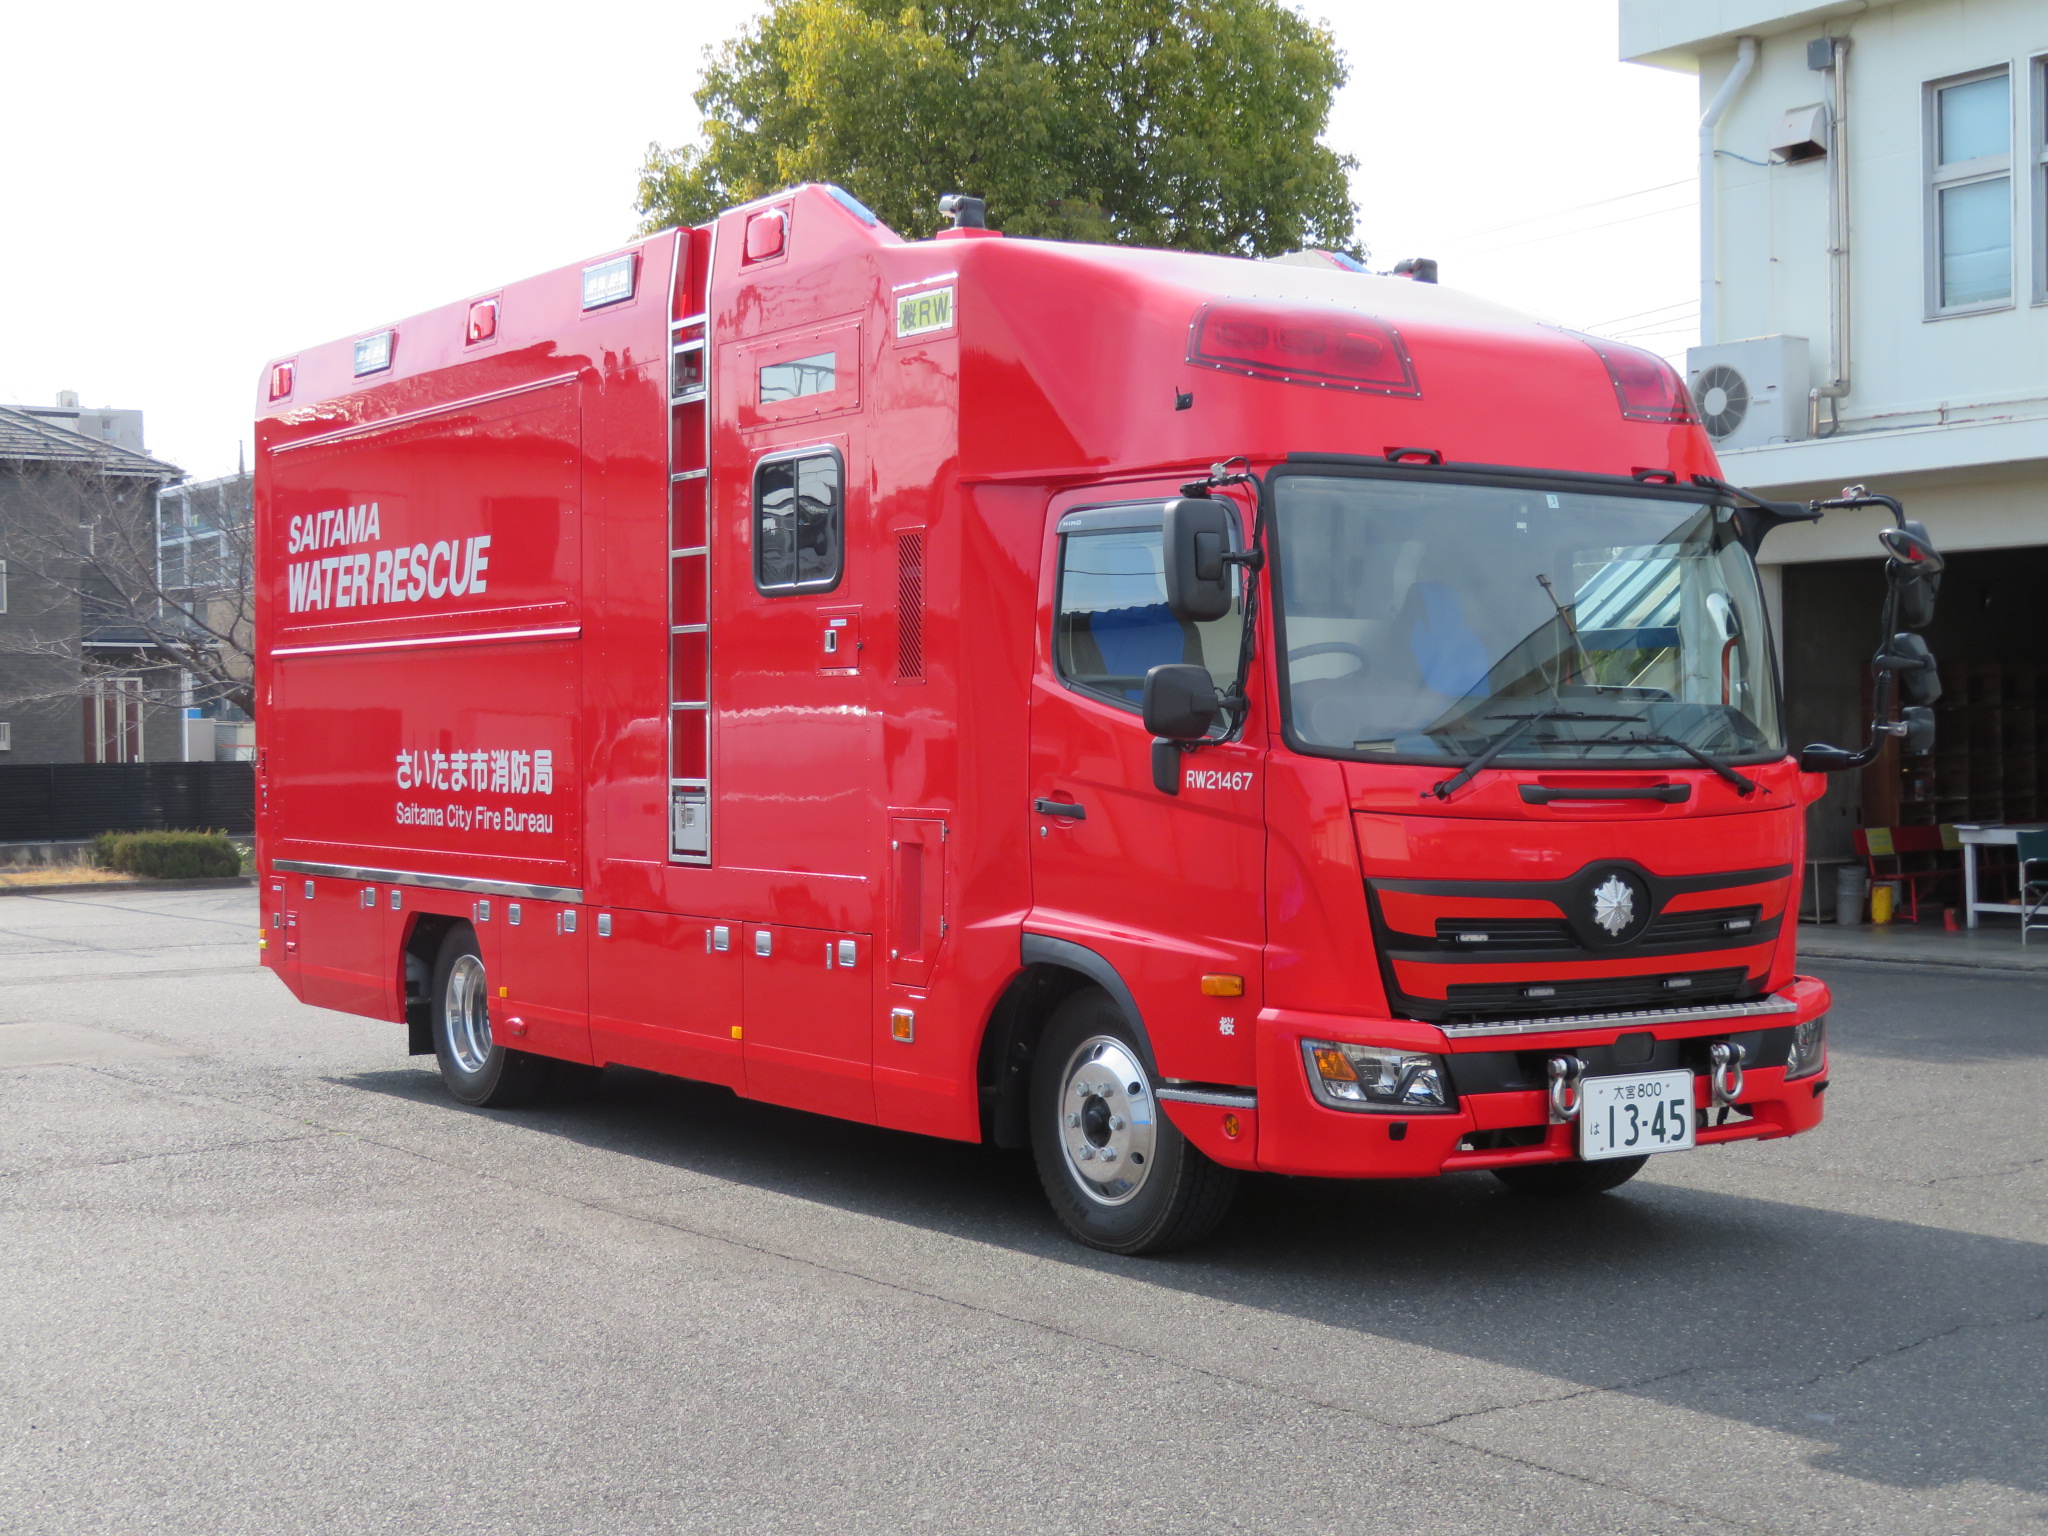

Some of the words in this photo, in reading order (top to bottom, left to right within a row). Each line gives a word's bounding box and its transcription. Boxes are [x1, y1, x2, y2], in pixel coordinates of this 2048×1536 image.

[902, 295, 949, 329] 桜RW
[288, 502, 381, 554] SAITAMA
[288, 553, 371, 614] WATER
[372, 535, 492, 602] RESCUE
[396, 748, 553, 795] さいたま市消防局
[1186, 770, 1254, 791] RW21467
[396, 802, 444, 827] Saitama
[447, 804, 473, 831] City
[475, 806, 501, 830] Fire
[504, 807, 553, 834] Bureau
[1590, 1122, 1600, 1135] は
[1609, 1098, 1686, 1148] 13-45
